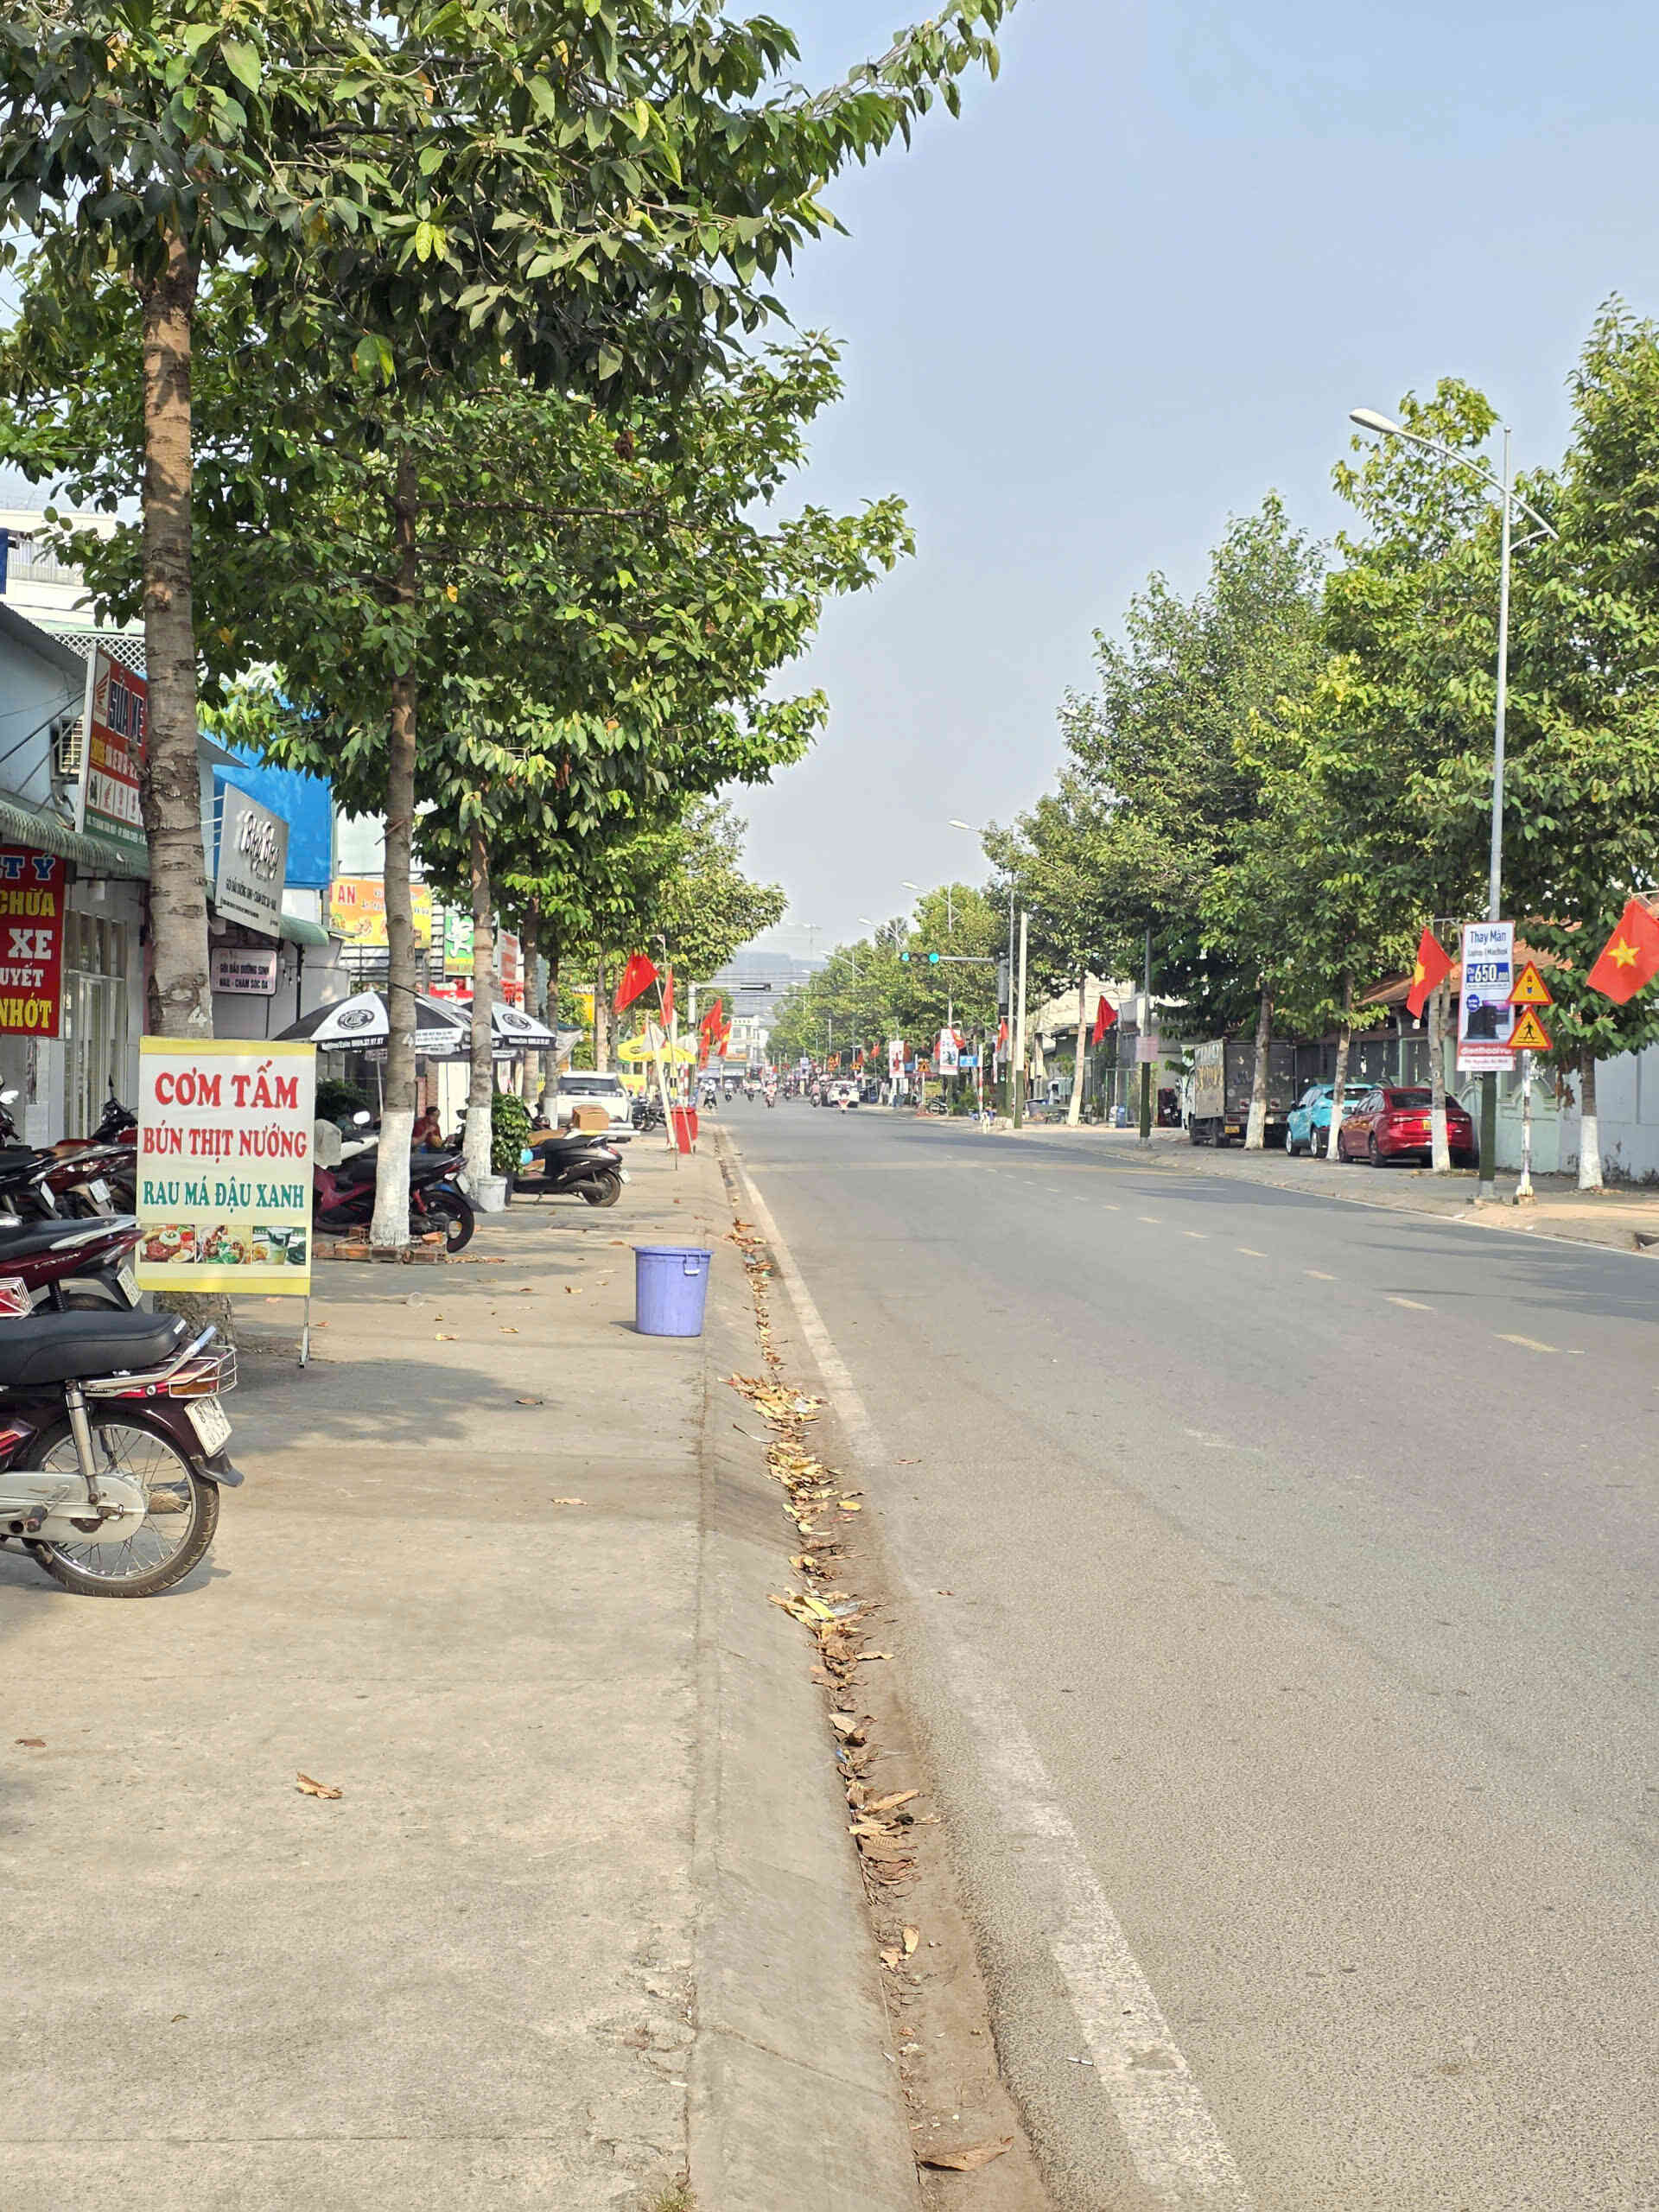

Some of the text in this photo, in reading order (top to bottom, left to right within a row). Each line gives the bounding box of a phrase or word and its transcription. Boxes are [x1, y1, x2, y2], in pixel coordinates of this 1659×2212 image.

[7, 927, 54, 960] XE
[1470, 930, 1488, 945] Thay
[0, 992, 53, 1028] NHỚT
[188, 1004, 208, 1028] 4
[154, 1060, 299, 1109] CƠM TẤM
[143, 1120, 308, 1164] BÚN THỊT NƯỚNG
[143, 1180, 181, 1206] RAU
[184, 1175, 210, 1207] MÁ
[214, 1176, 251, 1213] ĐẬU
[256, 1182, 305, 1210] XANH
